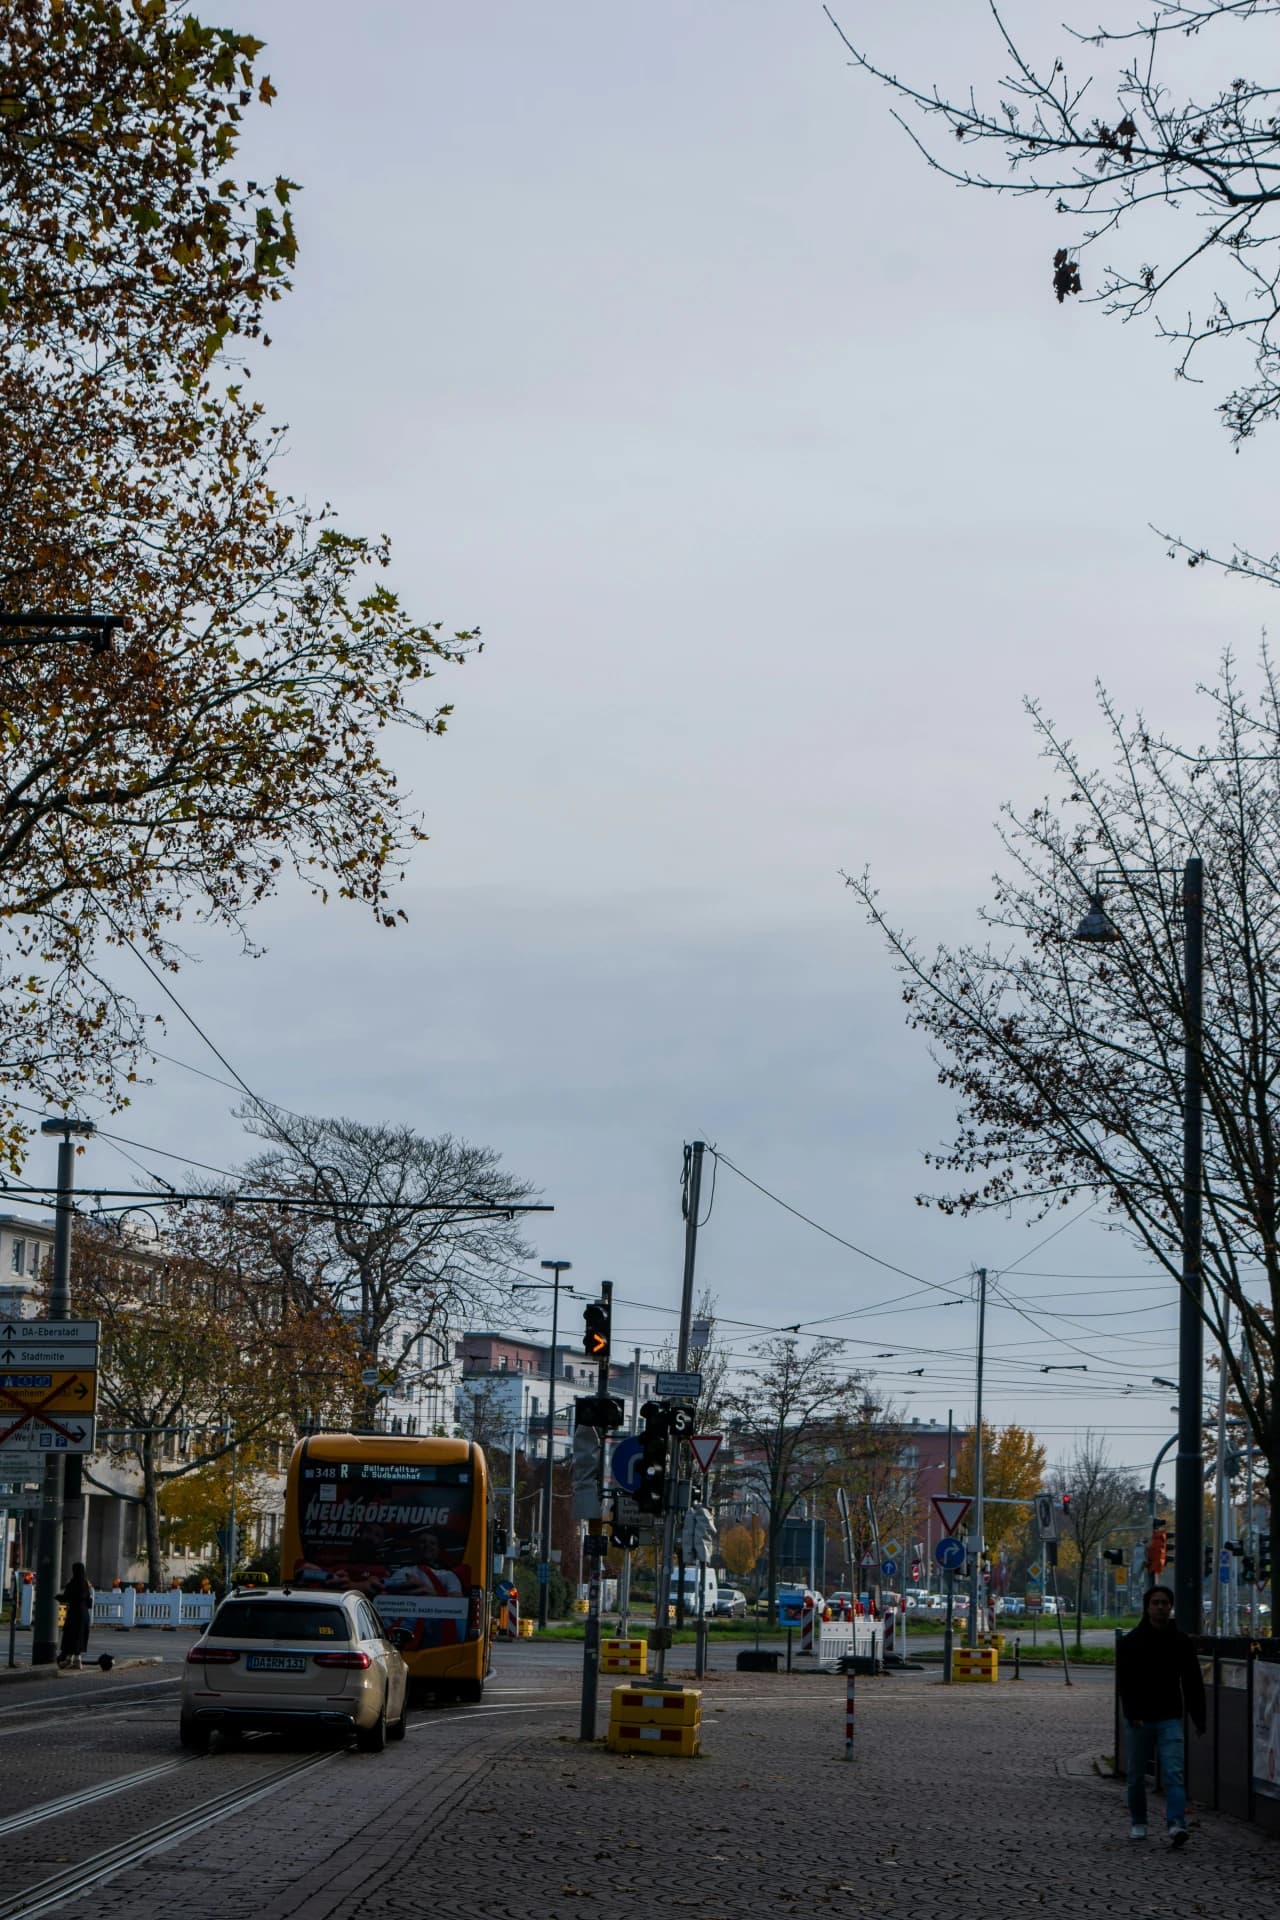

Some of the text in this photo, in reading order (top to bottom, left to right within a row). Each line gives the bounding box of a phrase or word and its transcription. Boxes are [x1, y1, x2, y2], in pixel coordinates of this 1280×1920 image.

[22, 1327, 79, 1337] DA-Eberstadt
[21, 1351, 65, 1361] Stadtmitte
[315, 1467, 336, 1479] 348
[340, 1463, 349, 1479] R
[304, 1502, 450, 1525] NEUERÖFFNUNG
[254, 1657, 266, 1667] DA
